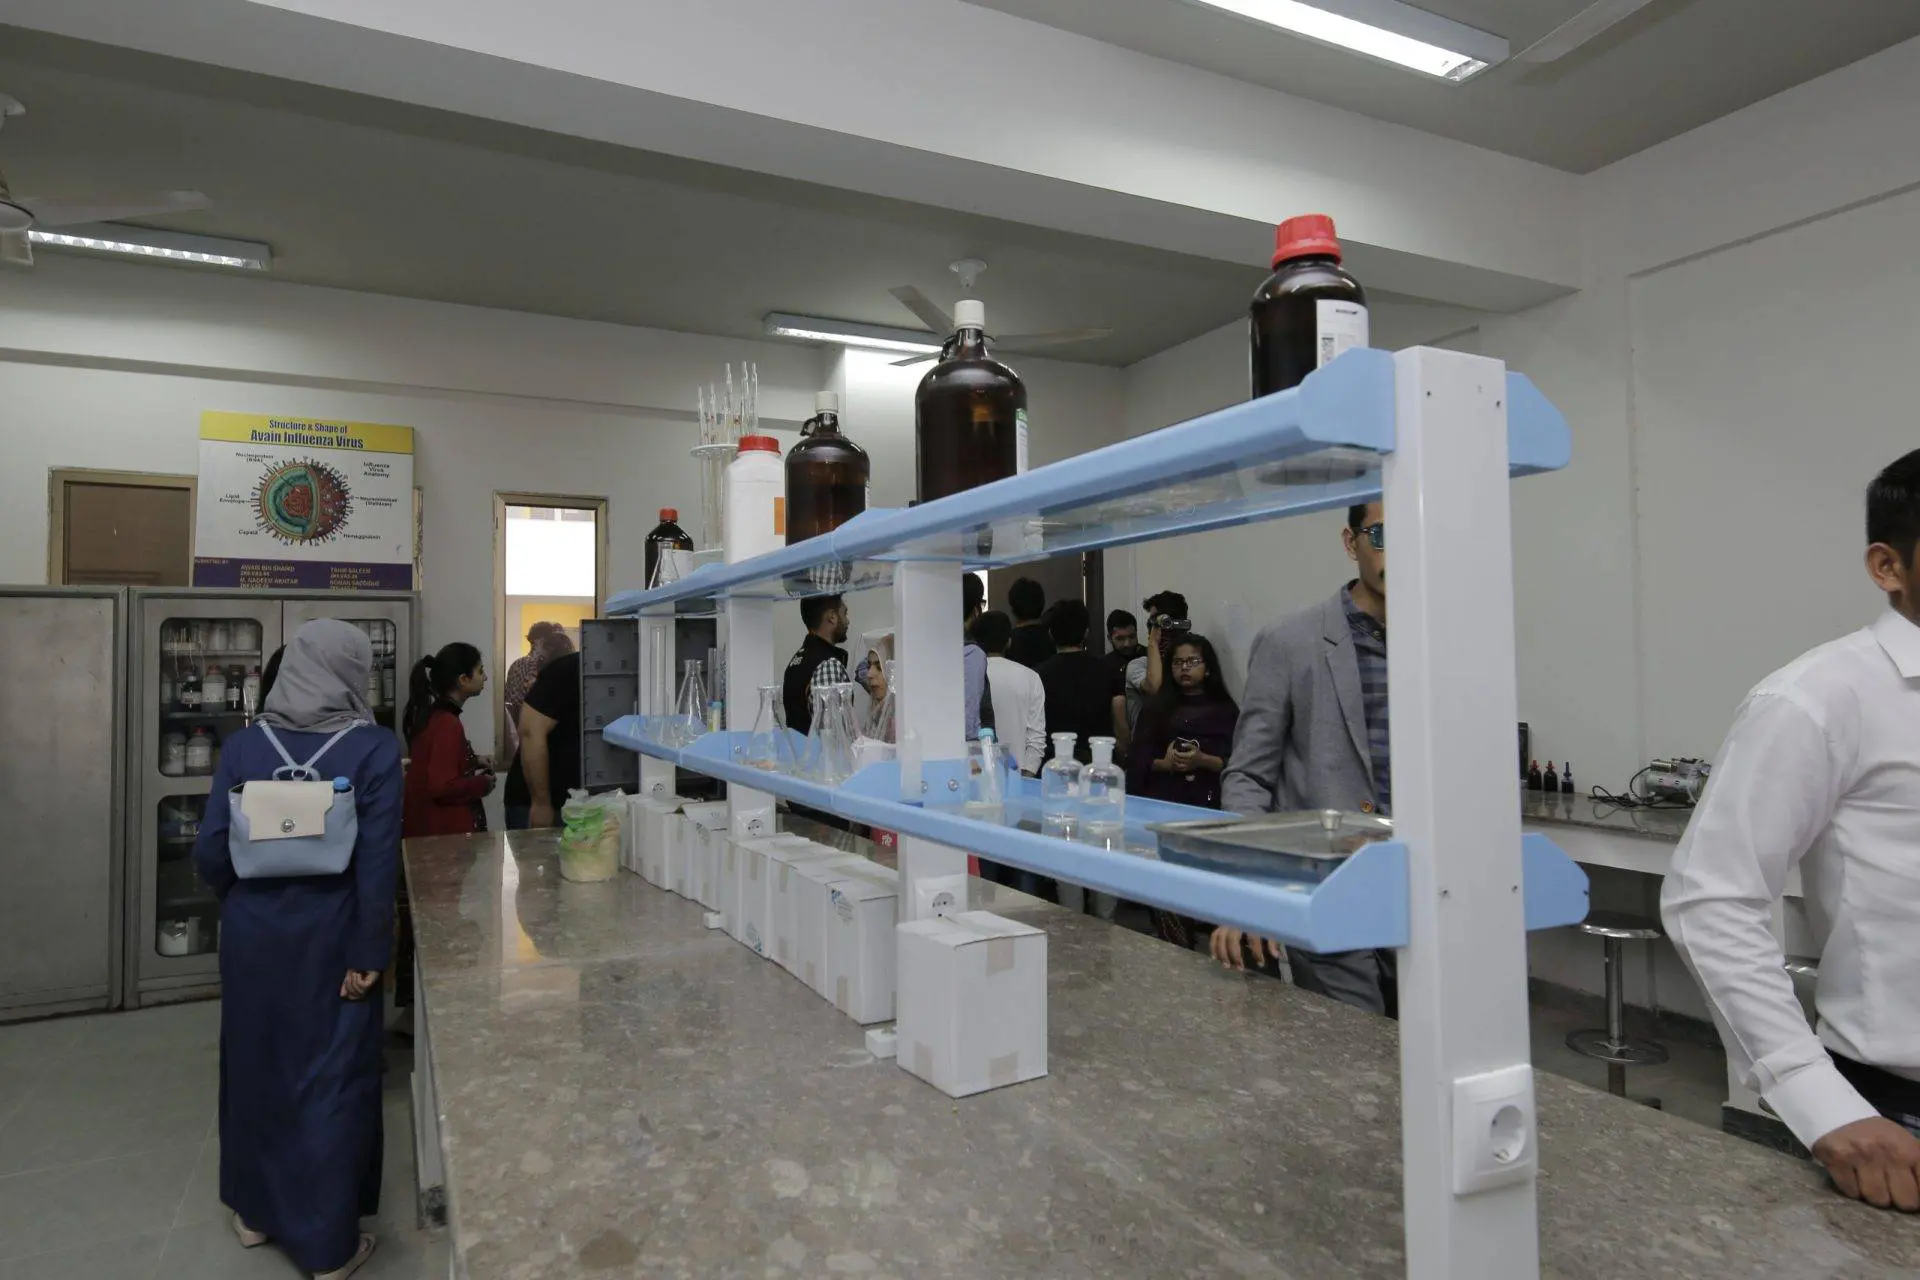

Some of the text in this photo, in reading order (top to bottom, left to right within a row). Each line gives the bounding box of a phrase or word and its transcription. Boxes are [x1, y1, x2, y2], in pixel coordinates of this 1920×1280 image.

[269, 420, 306, 431] Structure
[314, 422, 338, 433] Shape
[339, 425, 348, 434] of
[251, 430, 364, 448] Avain Influenza Virus
